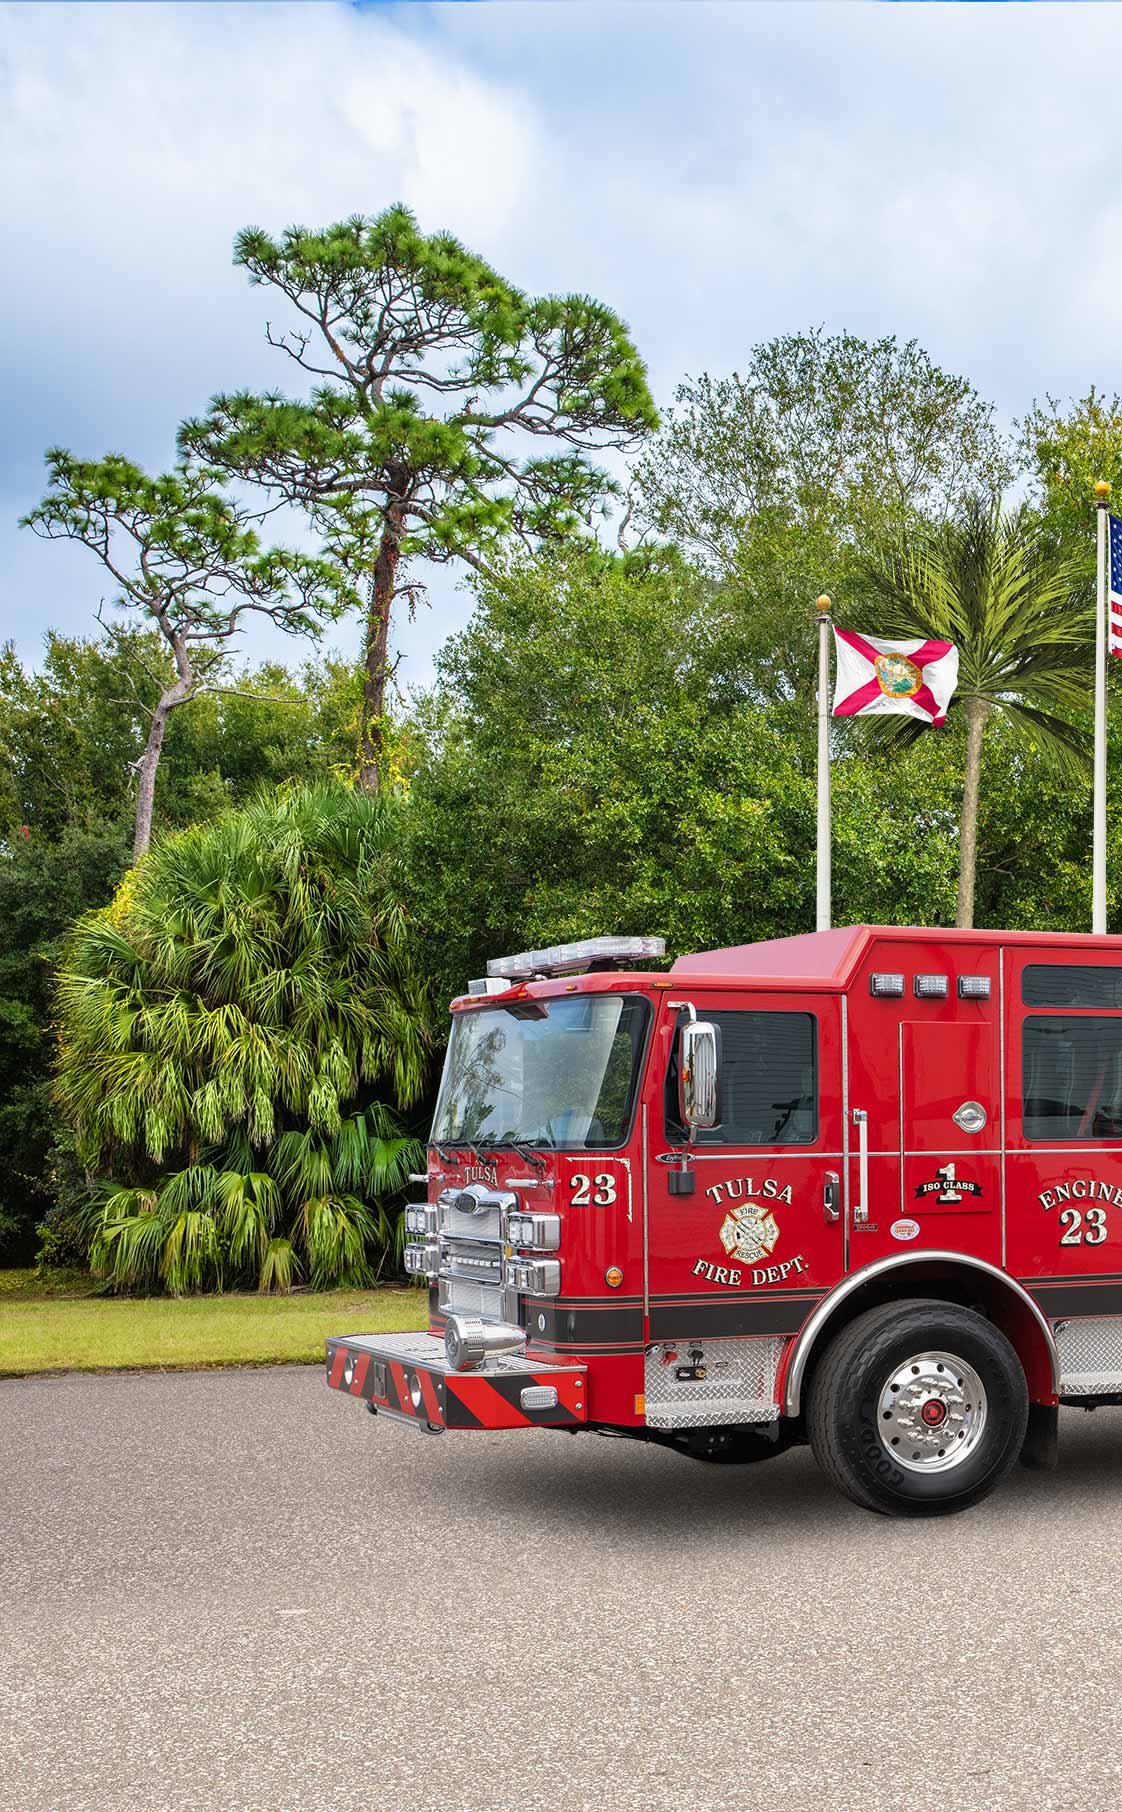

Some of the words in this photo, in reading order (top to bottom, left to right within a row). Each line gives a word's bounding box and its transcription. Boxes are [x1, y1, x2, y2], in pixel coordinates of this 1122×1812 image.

[463, 1166, 498, 1187] TULSA
[569, 1173, 617, 1207] 23
[922, 1182, 941, 1193] ISO
[943, 1181, 975, 1192] CLASS
[936, 1163, 963, 1204] 1
[706, 1177, 793, 1205] TULSA
[739, 1207, 759, 1216] FIRE
[1059, 1208, 1108, 1247] 23
[735, 1249, 764, 1260] RESCUE
[691, 1259, 742, 1287] FIRE
[752, 1254, 810, 1287] DEPT.
